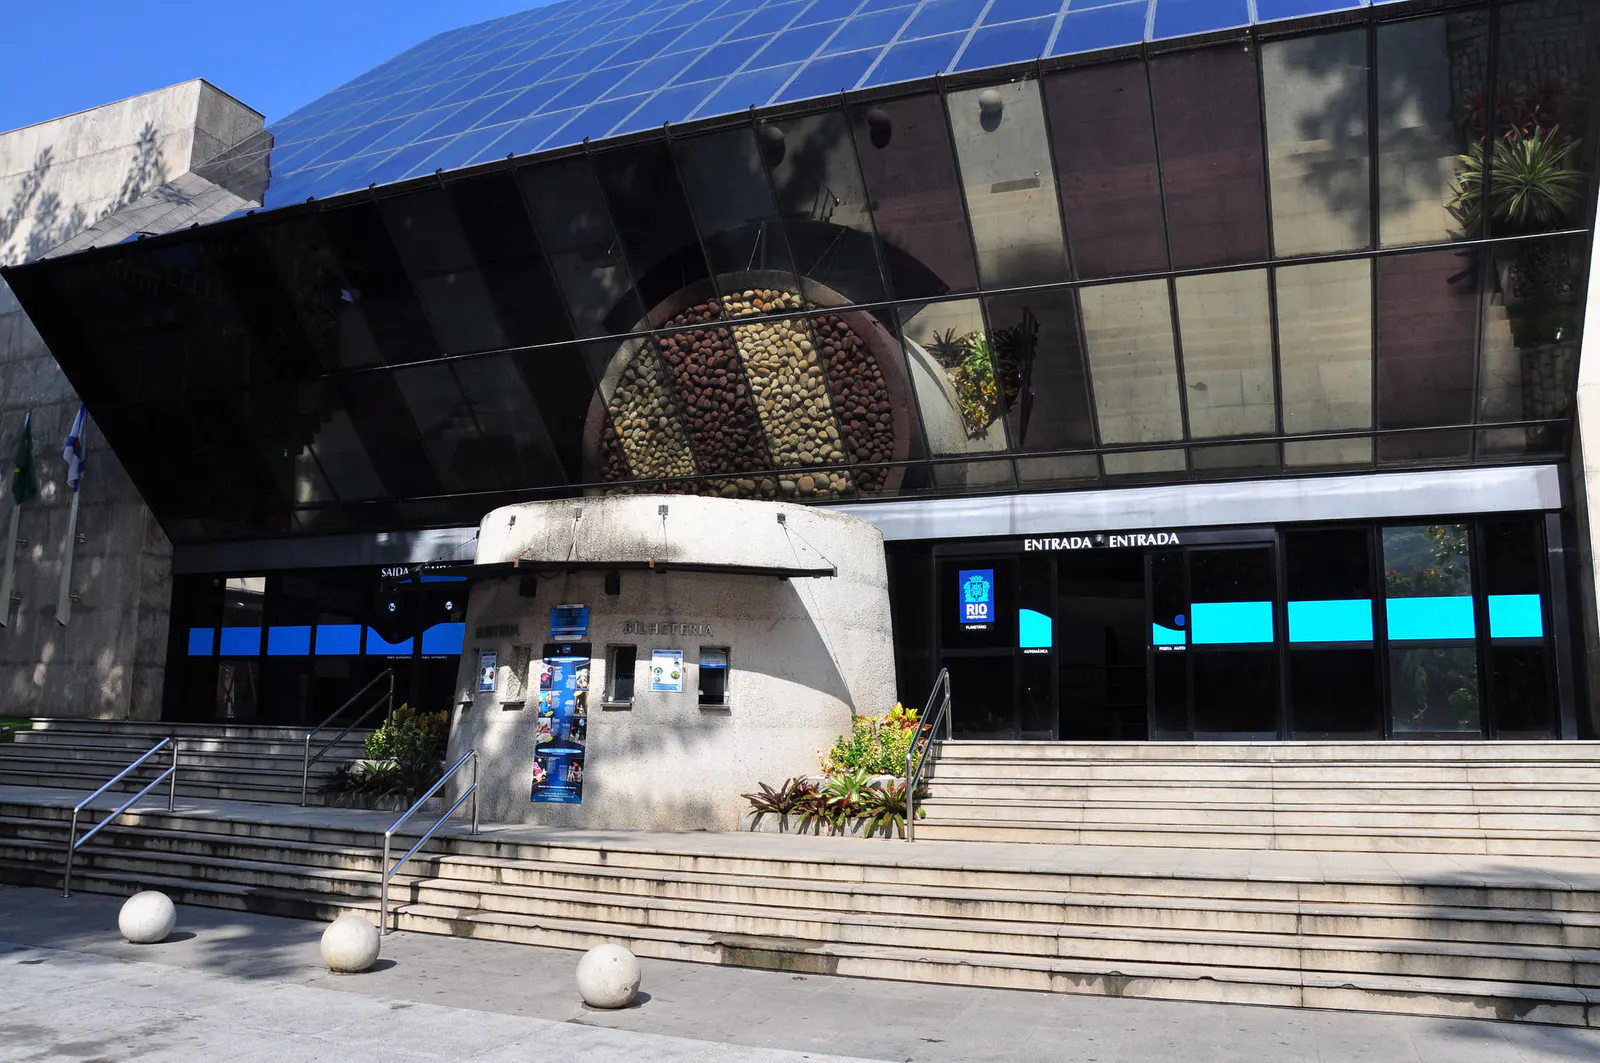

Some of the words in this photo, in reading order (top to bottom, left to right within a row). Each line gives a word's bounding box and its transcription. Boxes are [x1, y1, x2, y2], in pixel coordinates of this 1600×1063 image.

[1024, 536, 1092, 551] ENTRADA
[1109, 532, 1180, 548] ENTRADA
[966, 603, 988, 615] RIO
[623, 620, 714, 637] BILHETERIA
